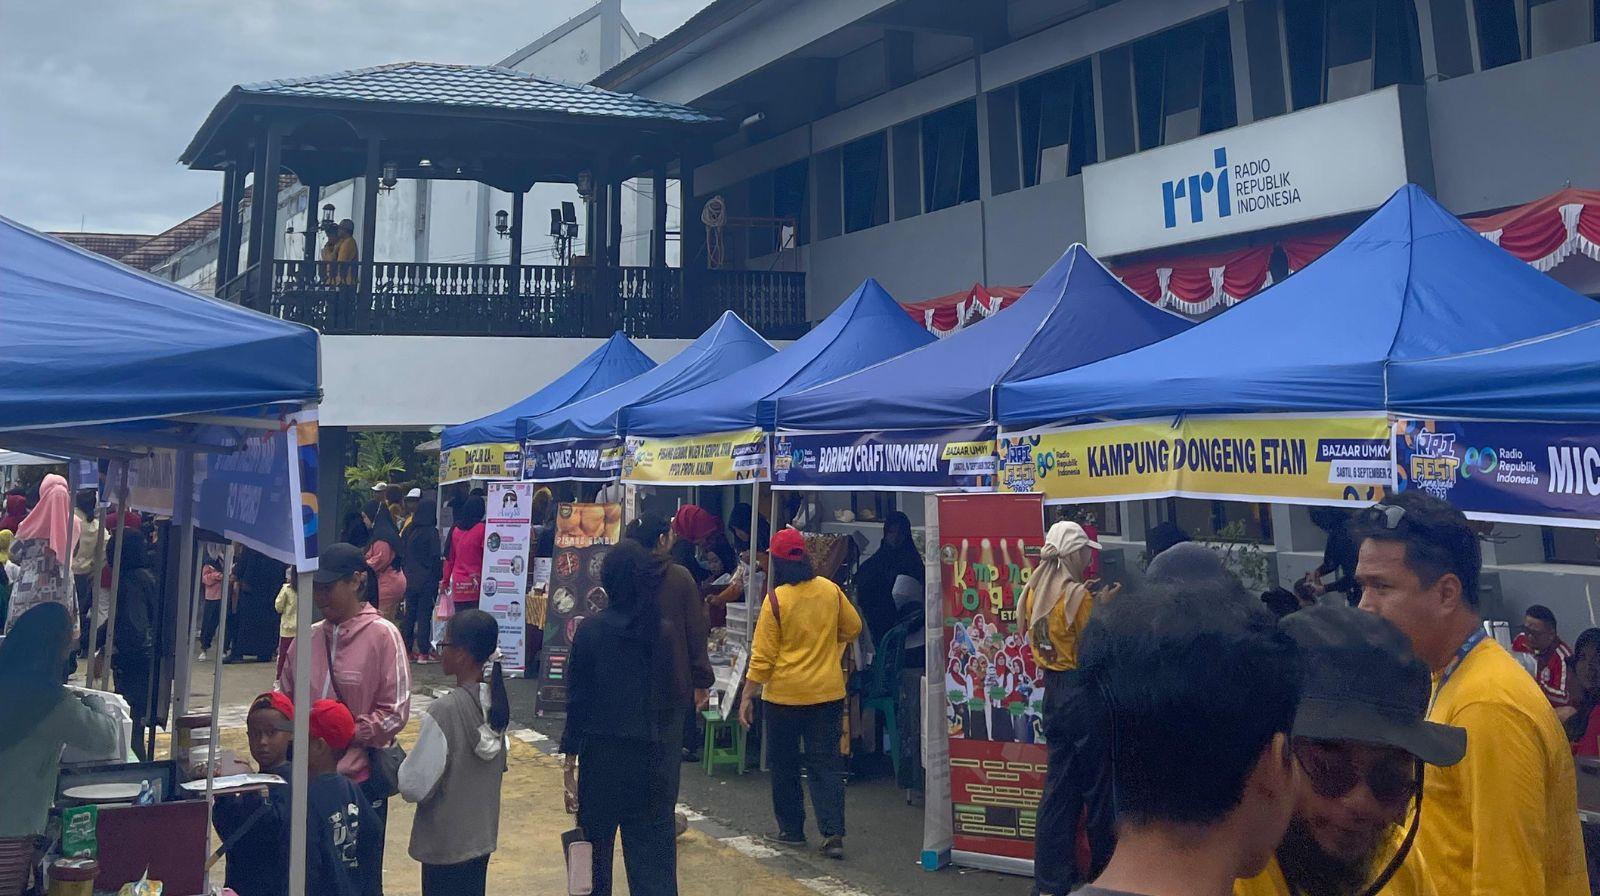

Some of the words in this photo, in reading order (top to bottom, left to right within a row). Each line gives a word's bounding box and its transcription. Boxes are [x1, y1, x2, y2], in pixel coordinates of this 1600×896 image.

[1234, 158, 1271, 179] RADIO
[1162, 147, 1231, 228] rri
[1236, 171, 1291, 197] REPUBLIK
[1237, 188, 1302, 214] INDONESIA
[818, 446, 854, 473] BORNEO
[854, 444, 883, 472] CRAFT
[885, 443, 939, 472] INDONESIA
[1056, 450, 1070, 459] Radio
[1087, 440, 1169, 478] KAMPUNG
[1173, 438, 1257, 474] DONGENG
[1261, 438, 1308, 475] ETAM
[1322, 444, 1360, 457] BAZAAR
[1362, 444, 1391, 458] UMKM
[1499, 447, 1523, 459] Radio
[1056, 459, 1078, 468] Republik
[1411, 455, 1460, 483] FEST
[1499, 460, 1537, 476] Republik
[1357, 467, 1387, 479] SEPTEMBER
[1496, 473, 1539, 485] Indonesia
[1001, 610, 1018, 621] ETA
